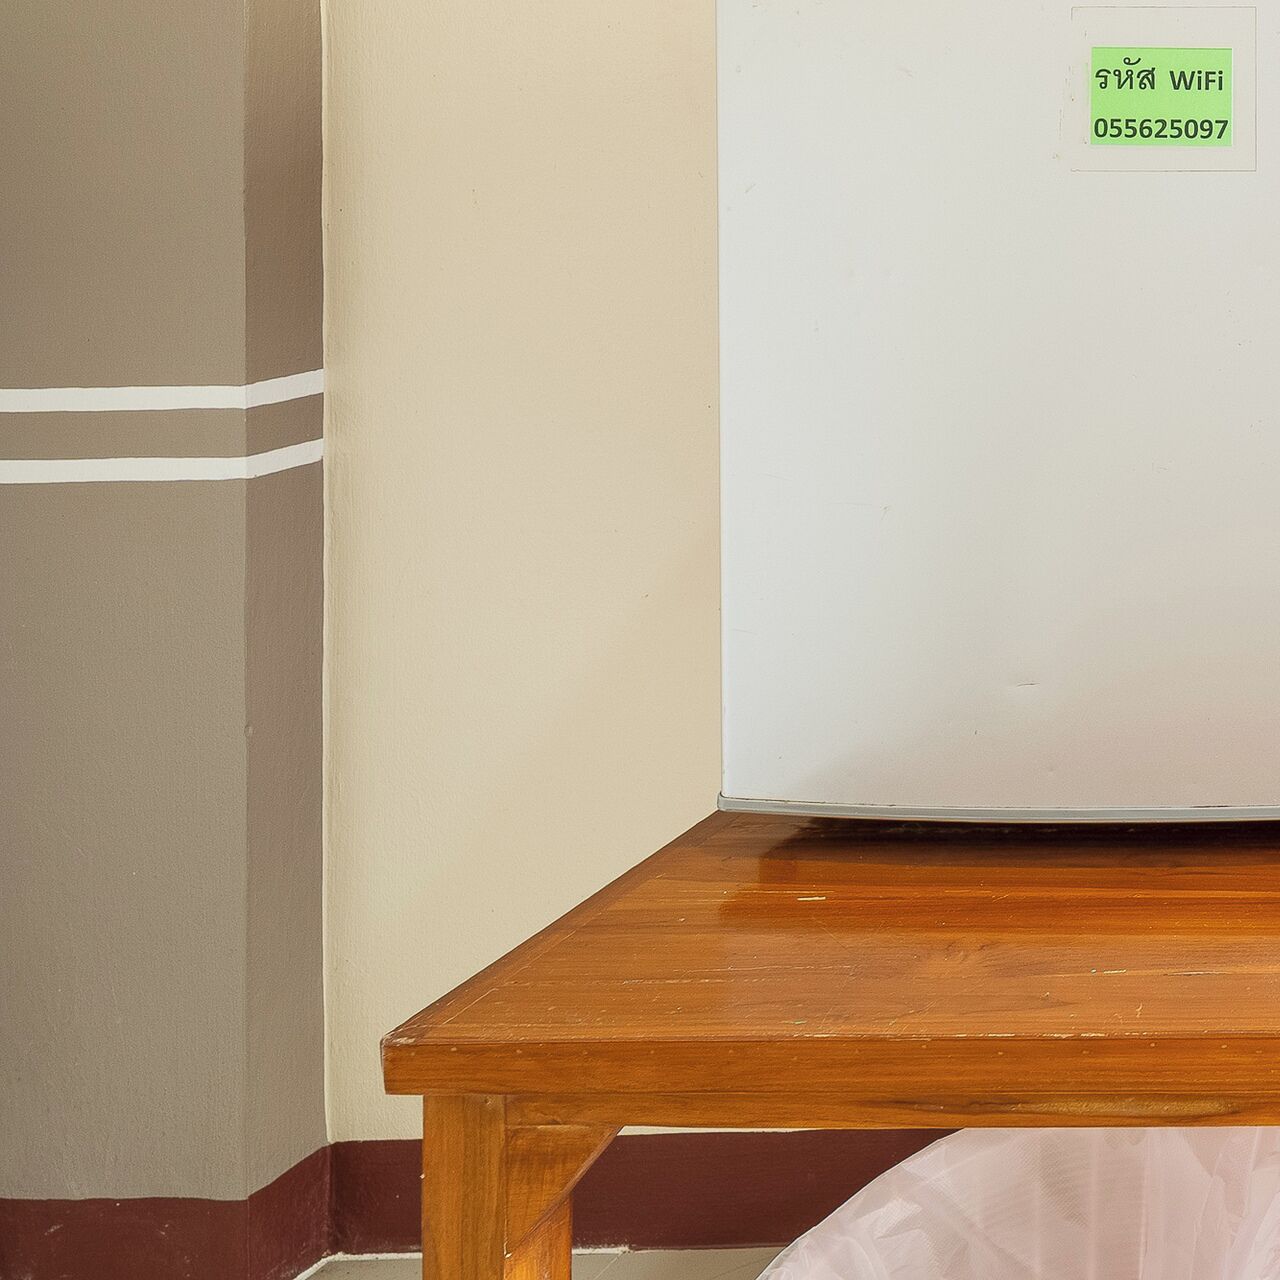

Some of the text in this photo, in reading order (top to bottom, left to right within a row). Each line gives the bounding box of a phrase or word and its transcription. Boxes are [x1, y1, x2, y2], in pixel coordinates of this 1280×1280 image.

[1095, 57, 1224, 91] รหัส WiFi
[1094, 118, 1229, 140] 055625097
